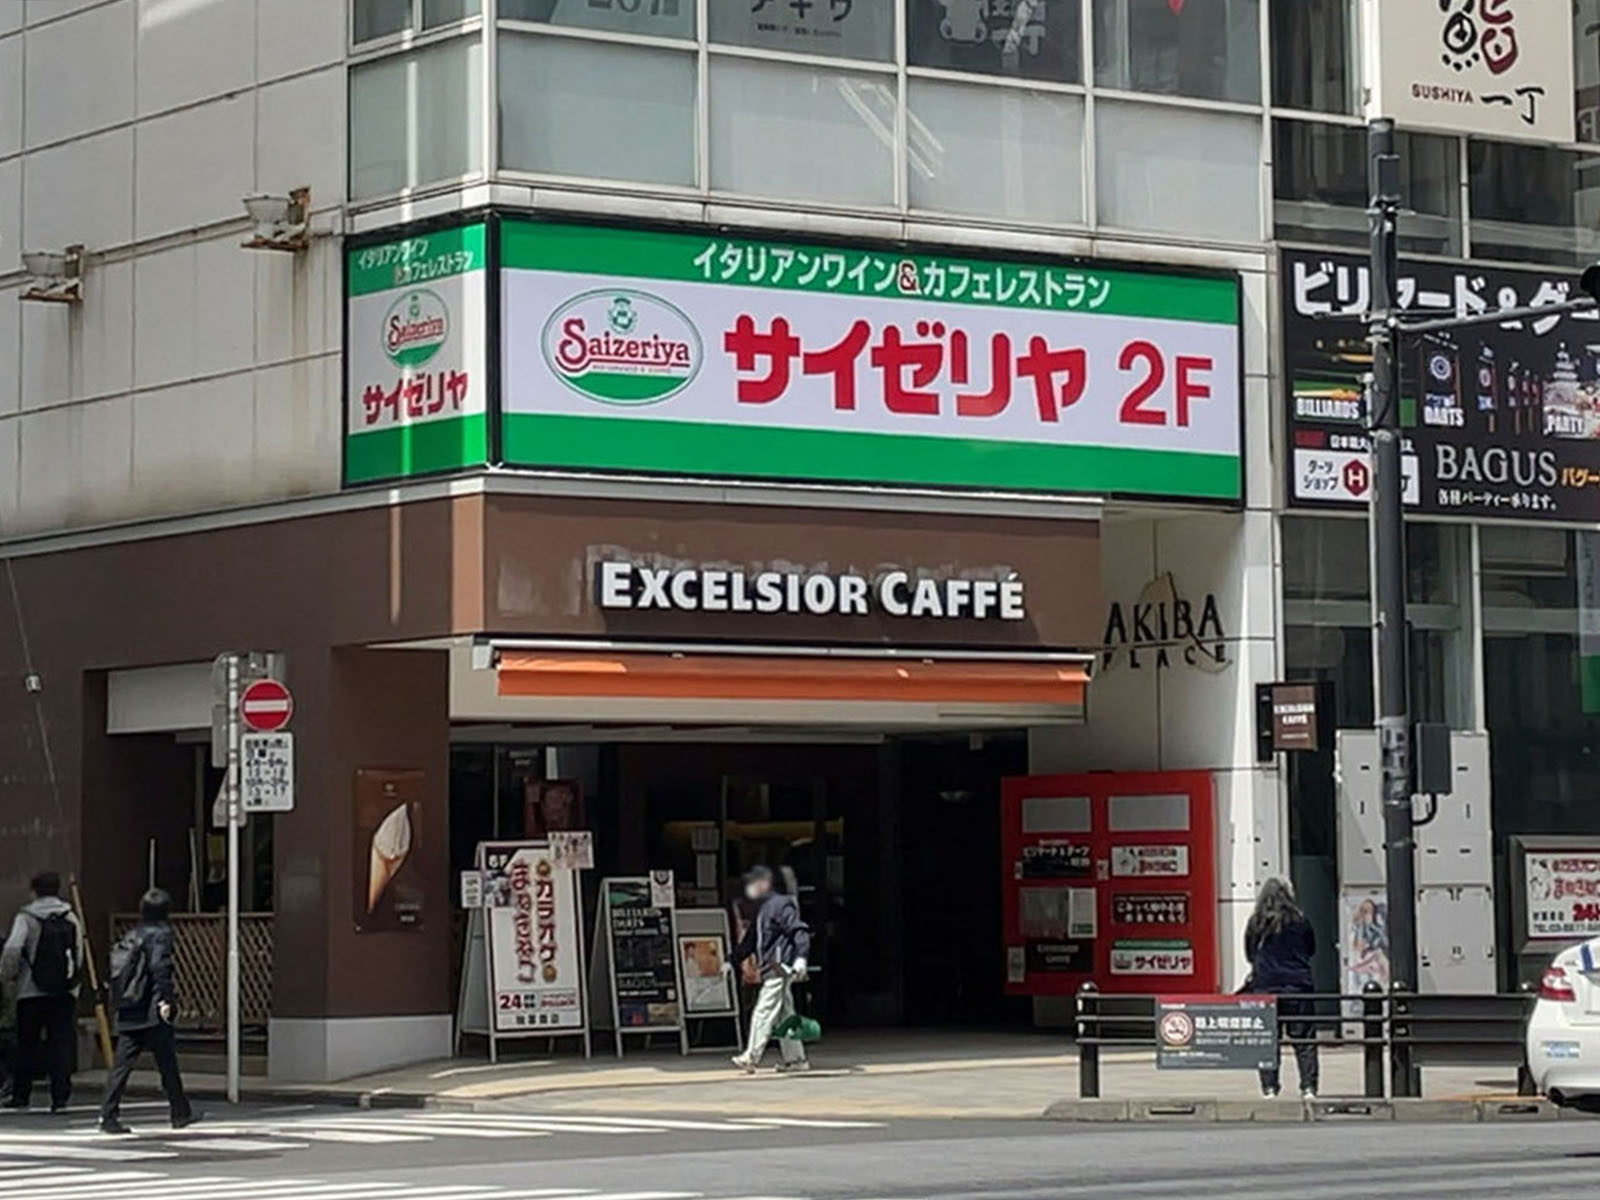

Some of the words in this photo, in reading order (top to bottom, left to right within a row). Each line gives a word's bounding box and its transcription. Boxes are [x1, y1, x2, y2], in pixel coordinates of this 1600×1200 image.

[1411, 83, 1474, 104] SUSHIYA
[1480, 86, 1545, 125] 一丁
[693, 242, 1111, 308] イタリアンワイン&カフェレストラン
[387, 315, 445, 352] Saizeriya
[557, 318, 691, 370] Saizeriya
[724, 314, 1087, 424] サイゼリヤ
[1118, 339, 1213, 428] 2F
[362, 369, 469, 425] サイゼリヤ
[1423, 405, 1465, 427] DARTS
[1545, 413, 1585, 435] PARTY
[1435, 444, 1558, 487] BAGUS
[600, 561, 869, 615] EXCELSIOR
[880, 570, 1025, 620] CAFFÉ
[1103, 593, 1224, 645] AKIBA
[1102, 643, 1227, 672] PLACE
[536, 880, 558, 964] カラオケ
[1134, 954, 1191, 970] サイゼリヤ
[500, 994, 522, 1010] 24
